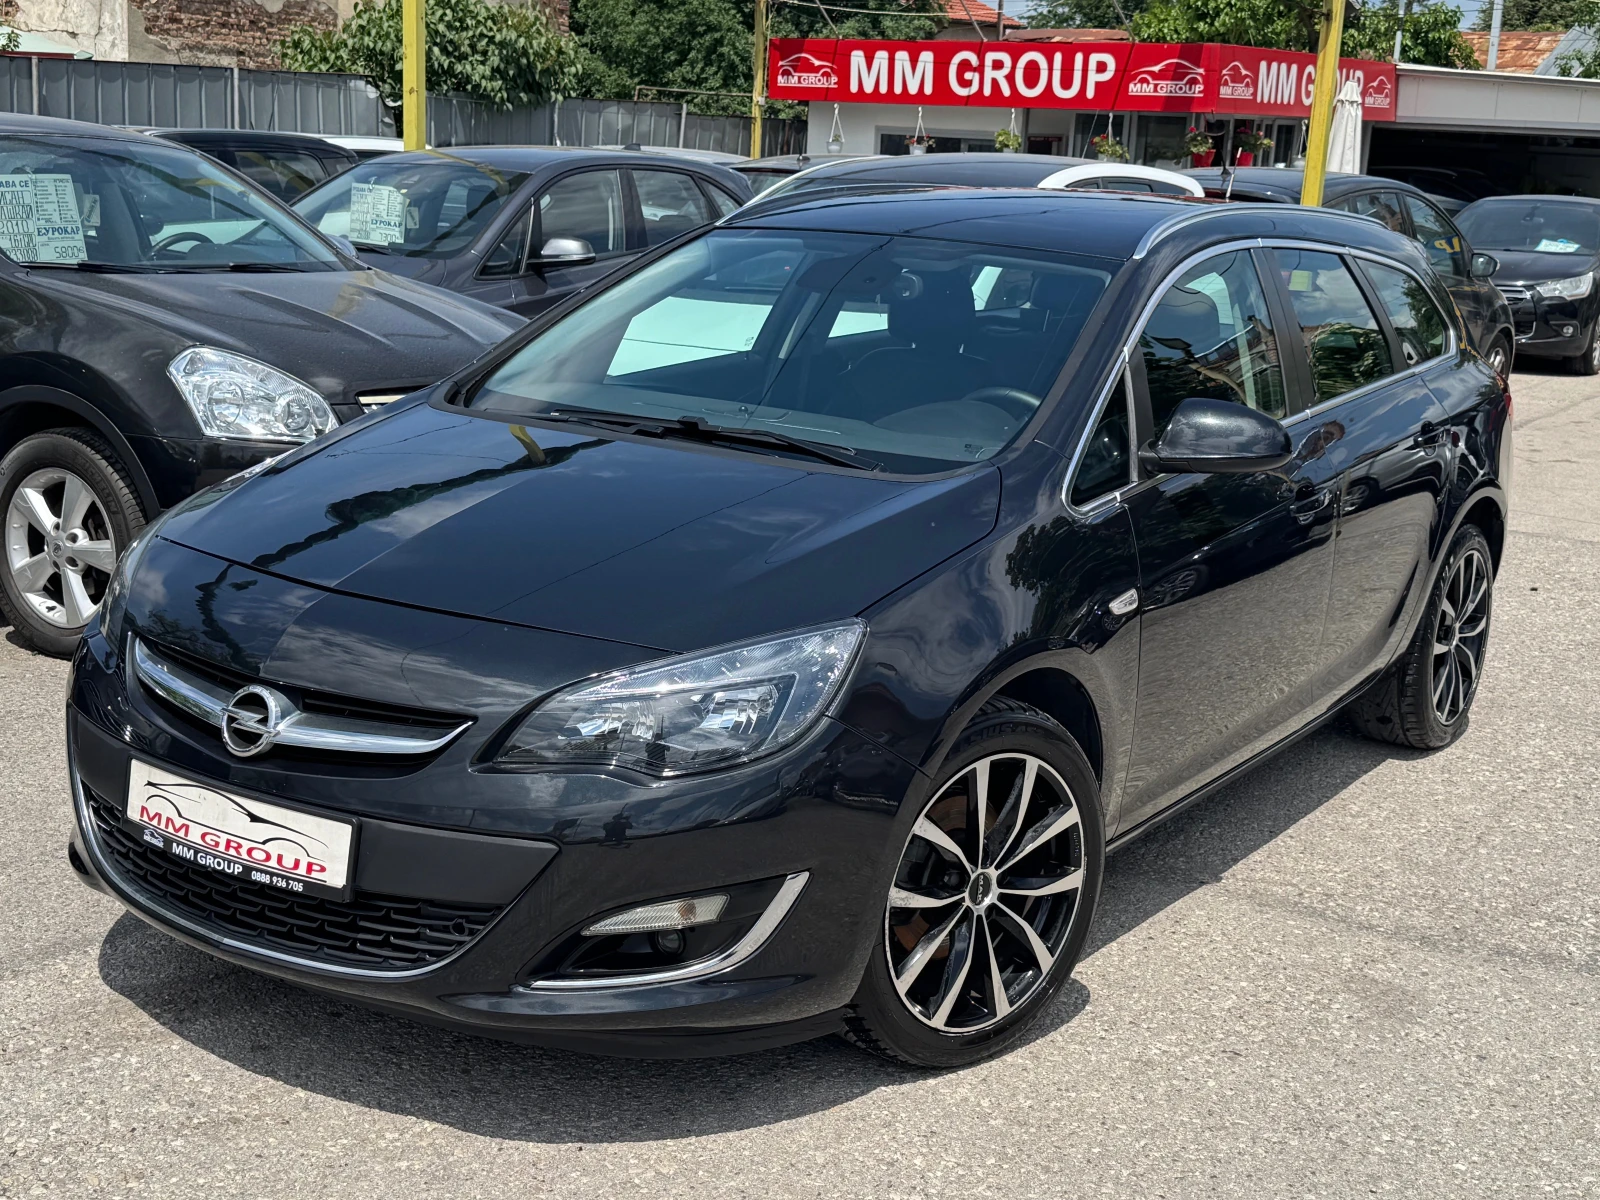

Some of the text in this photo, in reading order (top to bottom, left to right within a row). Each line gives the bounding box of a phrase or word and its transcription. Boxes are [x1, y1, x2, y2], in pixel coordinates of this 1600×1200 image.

[777, 75, 838, 86] MM GROUP
[850, 50, 1116, 99] MM GROUP
[1128, 83, 1204, 94] MM GROUP
[1256, 60, 1298, 105] MM
[1220, 85, 1254, 96] MM GROUP
[19, 180, 29, 188] СЕ
[140, 805, 327, 876] MM GROUP
[172, 842, 195, 861] MM
[197, 852, 243, 875] GROUP
[251, 870, 270, 884] 0888
[272, 876, 287, 887] 936
[288, 880, 304, 892] 705
